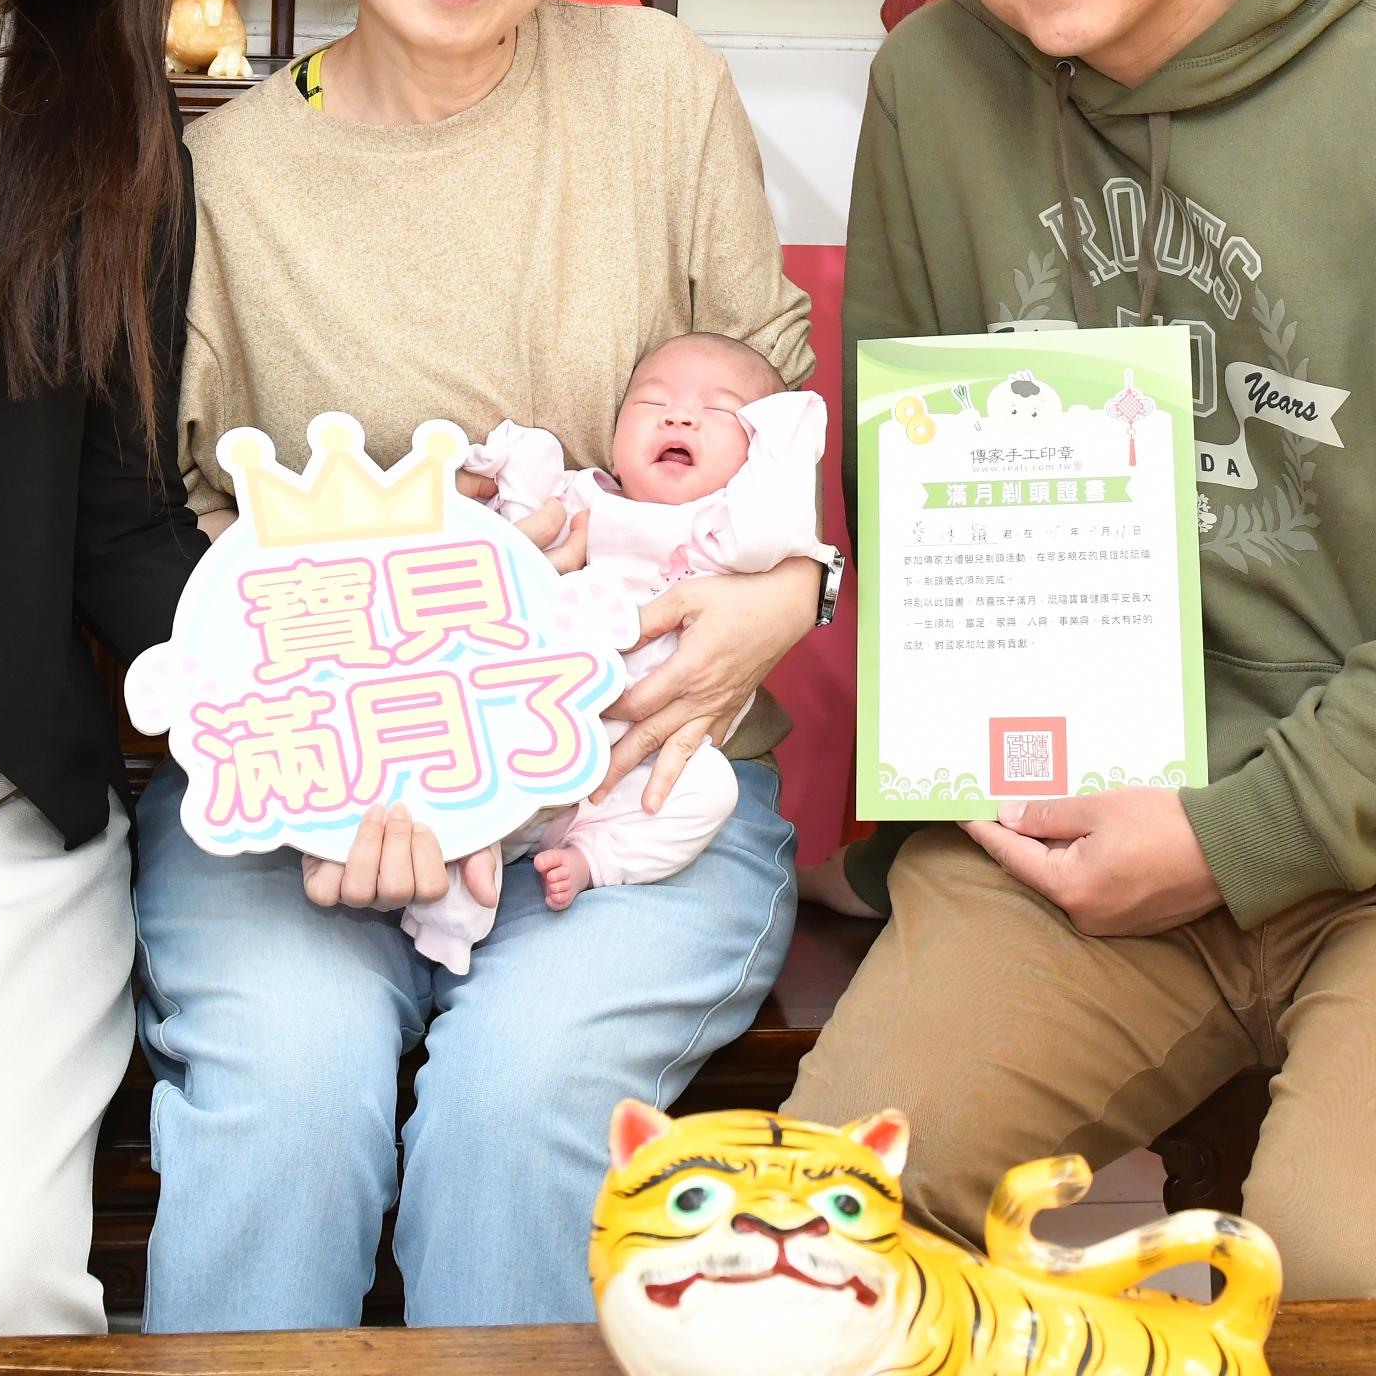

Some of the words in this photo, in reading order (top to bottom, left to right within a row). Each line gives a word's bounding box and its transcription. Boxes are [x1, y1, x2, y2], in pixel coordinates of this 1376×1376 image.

[1244, 372, 1319, 422] Years
[969, 446, 1075, 464] 傳家手工印章
[972, 463, 1072, 473] www.seals.com.tw
[946, 479, 1106, 507] 滿月剃頭證書
[237, 540, 528, 685] 寶貝
[190, 651, 598, 827] 滿月了
